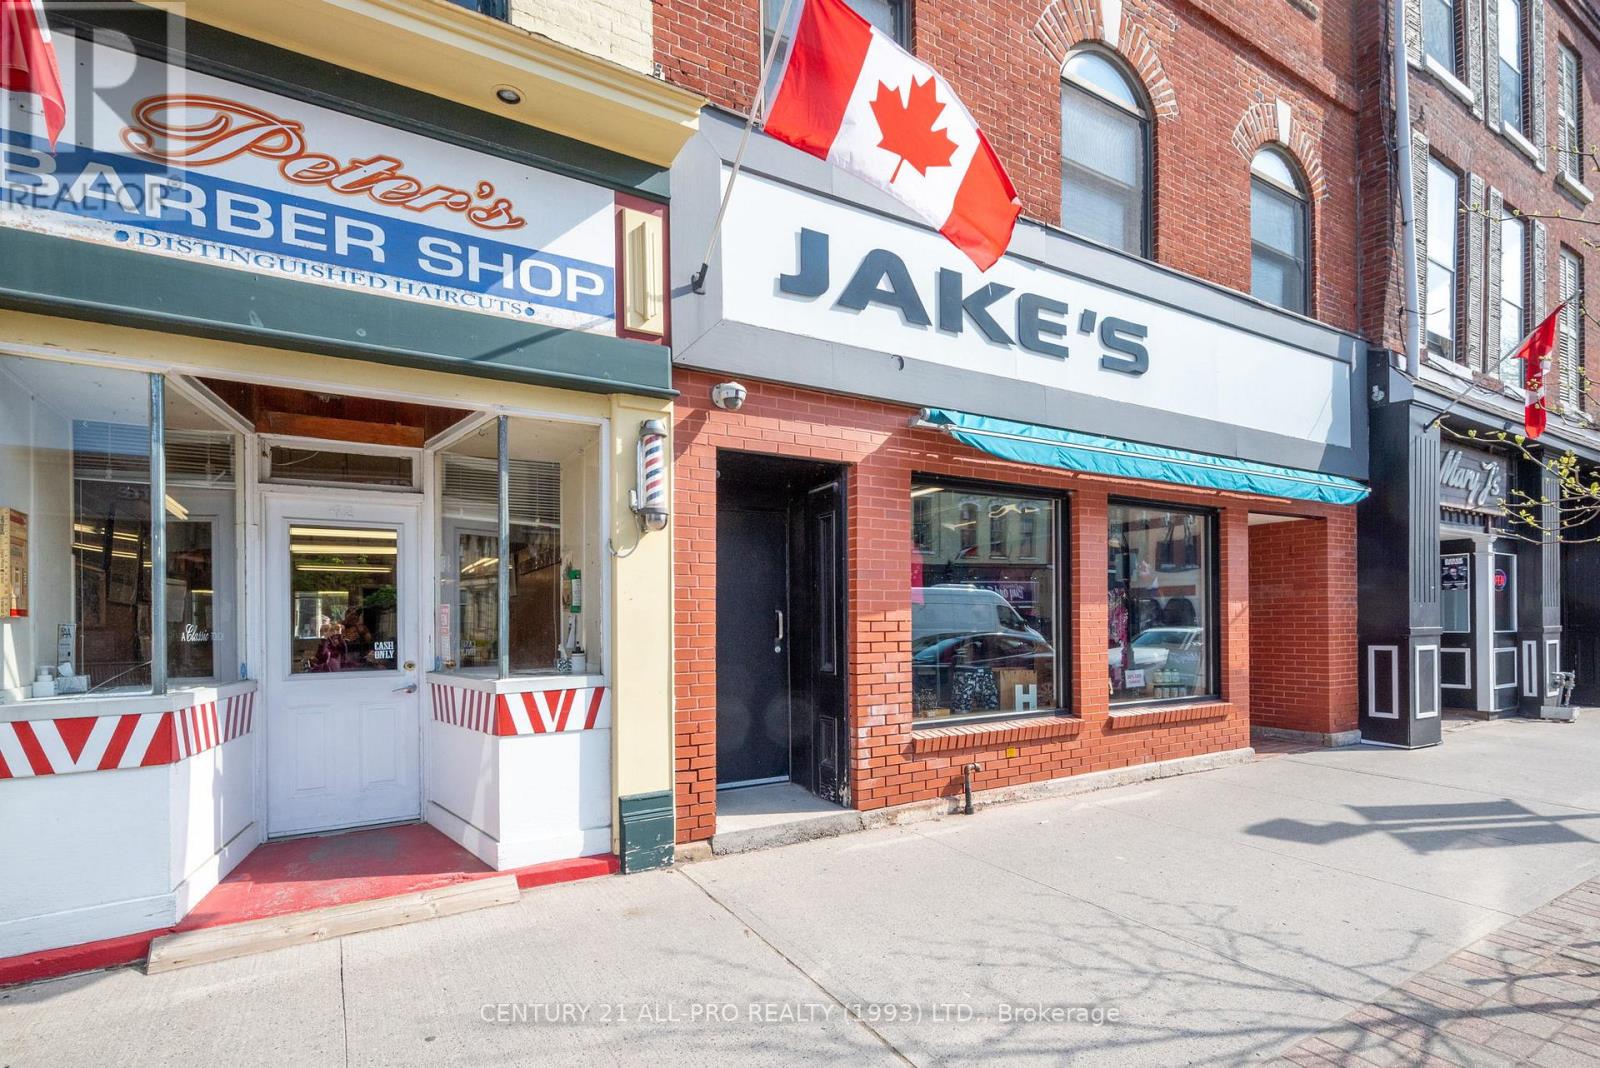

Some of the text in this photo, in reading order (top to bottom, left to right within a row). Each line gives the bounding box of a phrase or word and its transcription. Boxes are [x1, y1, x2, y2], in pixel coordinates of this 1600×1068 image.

[119, 93, 526, 230] Peter's
[1, 142, 605, 301] BARBER SHOP
[136, 231, 522, 315] DISTINGUISHED HAIRCUTS
[780, 227, 1149, 375] JAKE'S
[1440, 449, 1480, 504] Mary
[374, 641, 394, 650] CASH
[374, 650, 394, 659] ONLY
